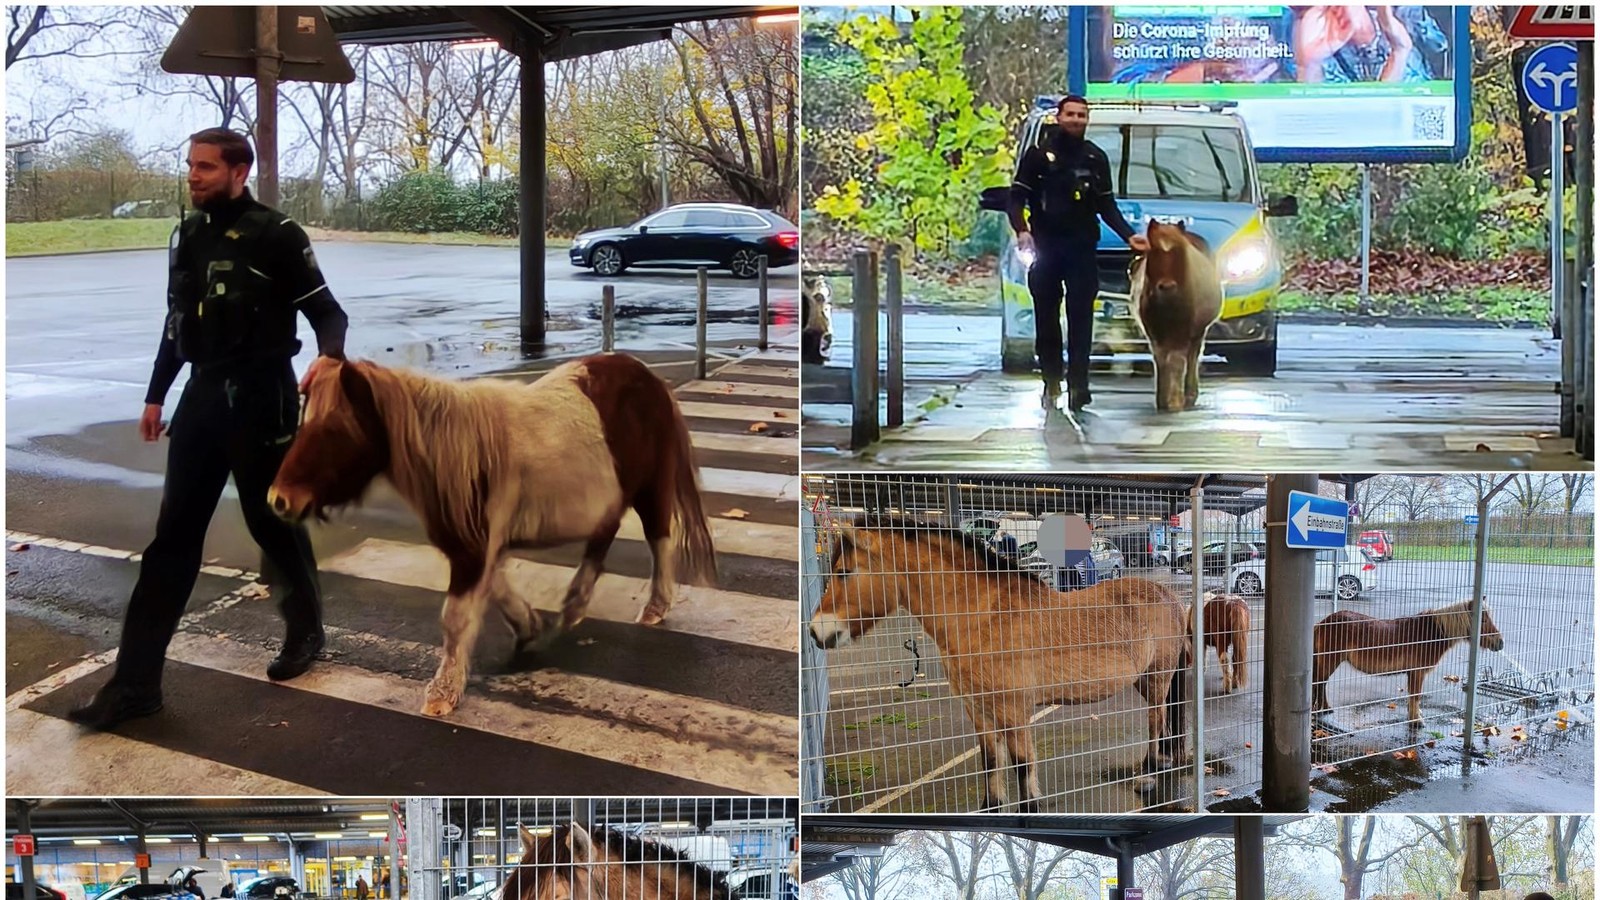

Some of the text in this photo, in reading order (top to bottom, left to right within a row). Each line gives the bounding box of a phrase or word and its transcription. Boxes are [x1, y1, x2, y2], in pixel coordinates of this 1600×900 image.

[1113, 23, 1270, 39] Die Corona-Impfung
[1113, 43, 1293, 59] schützt Ihre Gesundheit.
[1307, 515, 1344, 530] Einbahnstraße
[21, 843, 27, 853] 3
